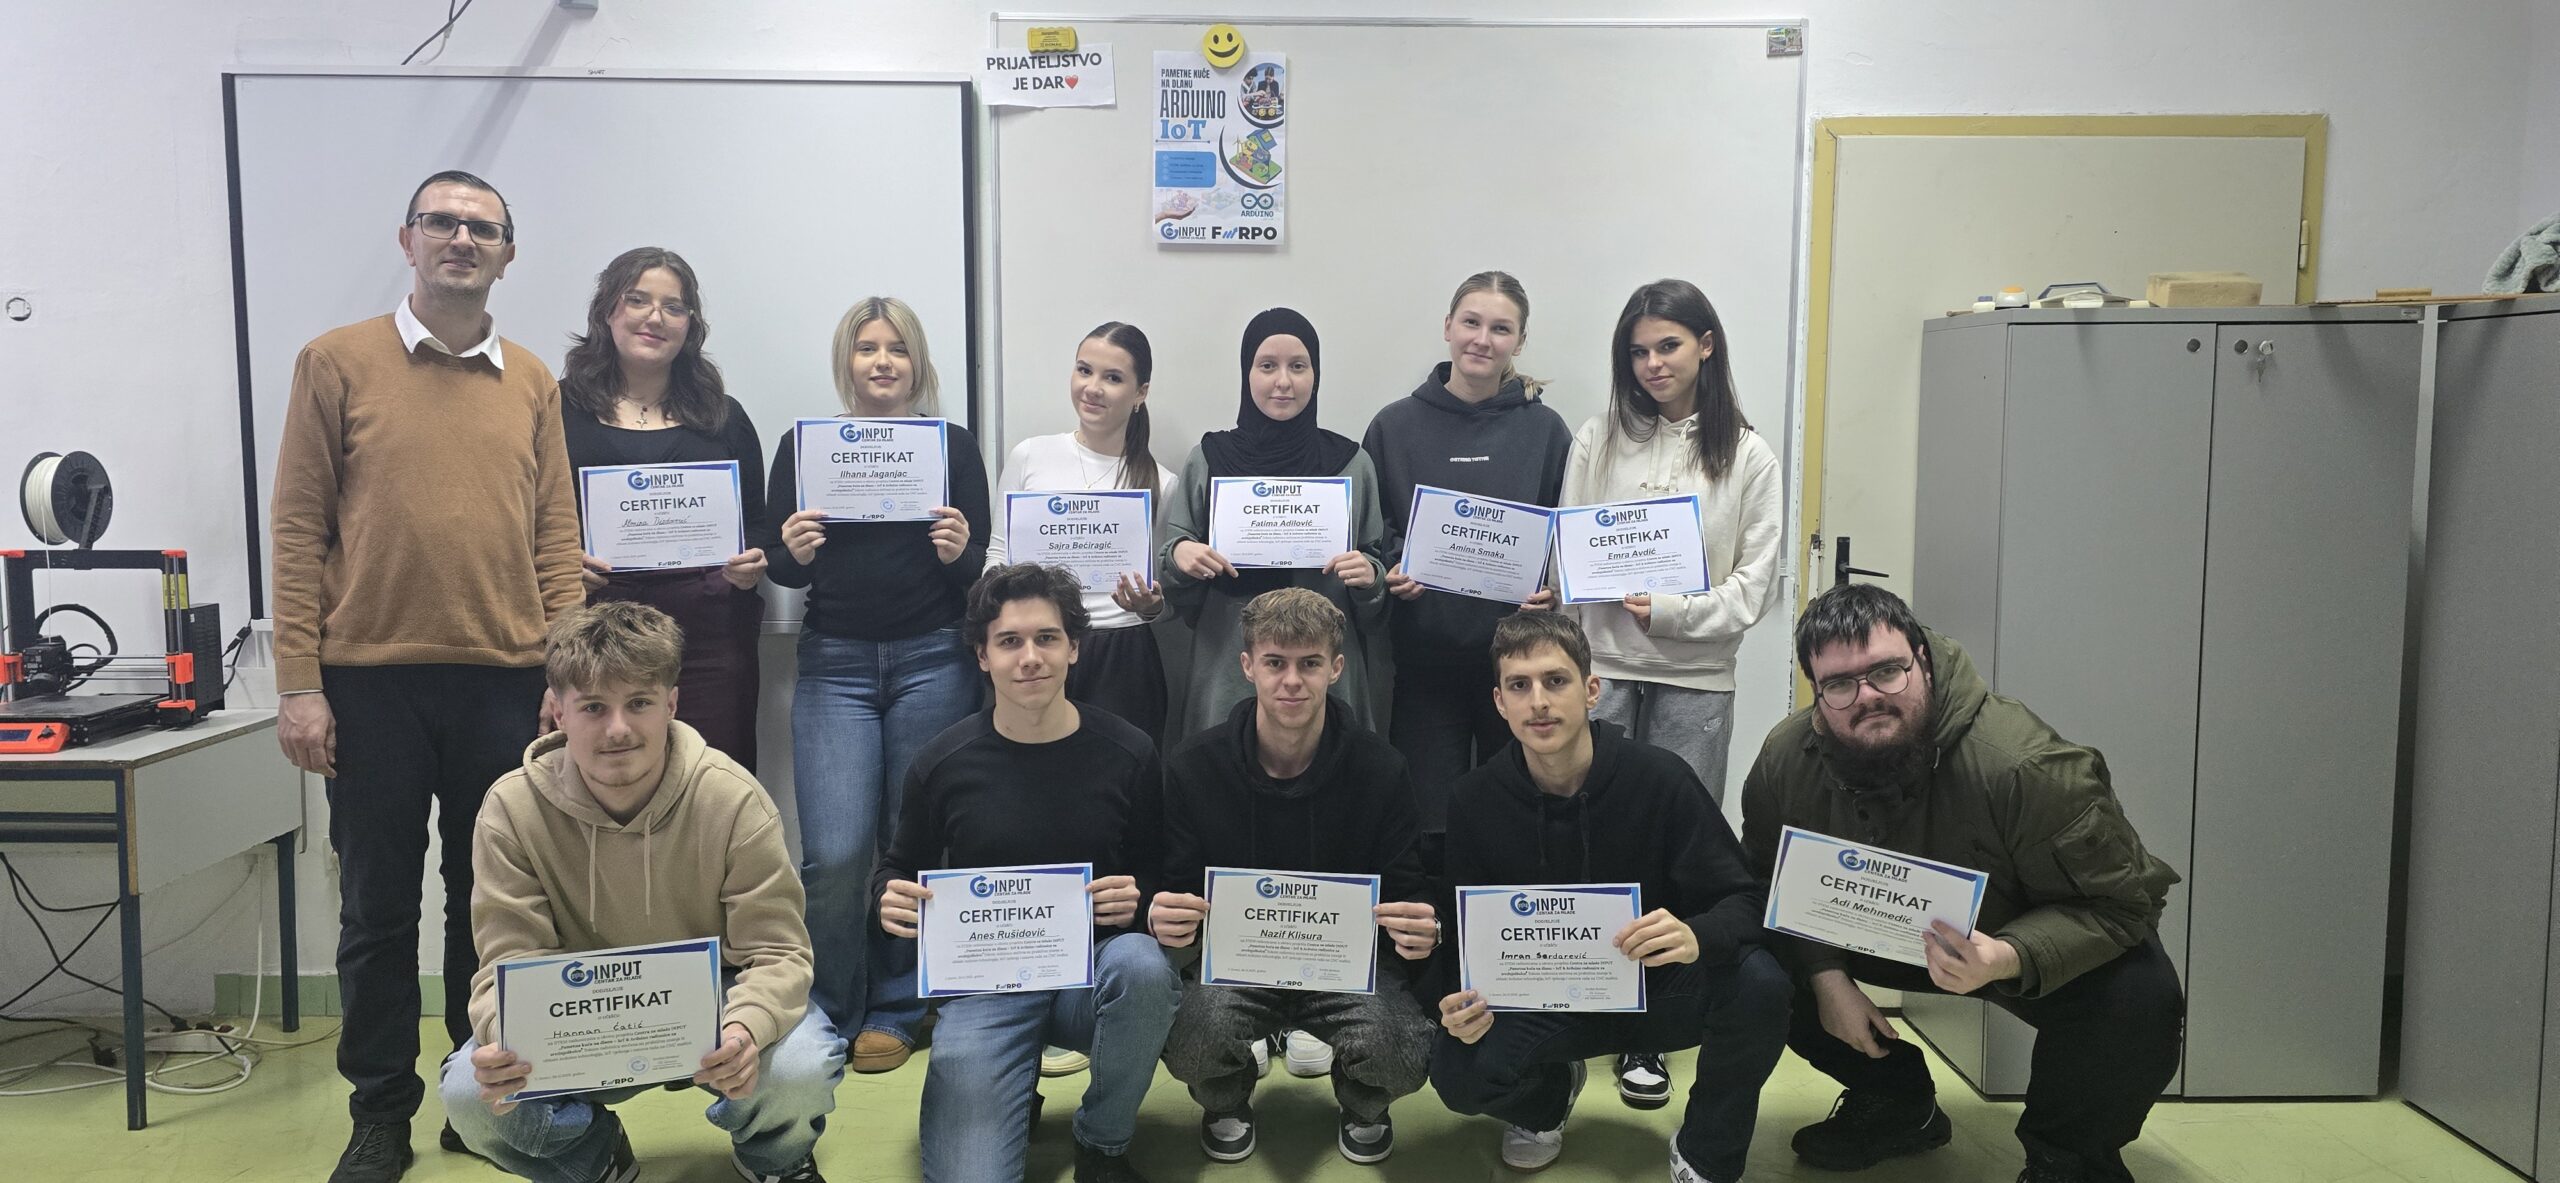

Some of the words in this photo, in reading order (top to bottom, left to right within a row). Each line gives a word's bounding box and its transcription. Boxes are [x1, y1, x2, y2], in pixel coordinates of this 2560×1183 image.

[986, 52, 1103, 71] PRIJATELJSTVO
[1160, 68, 1192, 79] PAMETNE
[1012, 77, 1028, 91] JE
[1032, 76, 1065, 90] DAR
[1160, 79, 1170, 89] NA
[1171, 79, 1193, 89] DLANU
[1159, 88, 1227, 119] ARDUINO
[1160, 119, 1207, 140] IoT
[1240, 210, 1275, 218] ARDUINO
[1178, 226, 1207, 238] INPUT
[861, 427, 894, 440] INPUT
[831, 451, 915, 464] CERTIFIKAT
[650, 473, 685, 485] INPUT
[868, 469, 908, 480] Jaganjac
[1271, 484, 1303, 495] INPUT
[619, 496, 707, 512] CERTIFIKAT
[1068, 499, 1100, 511] INPUT
[1243, 504, 1321, 515] CERTIFIKAT
[1473, 504, 1506, 522] INPUT
[1615, 508, 1648, 522] INPUT
[1039, 523, 1120, 536] CERTIFIKAT
[1250, 520, 1278, 528] Fatima
[1279, 519, 1313, 527] Adilović
[1441, 523, 1520, 547] CERTIFIKAT
[1589, 528, 1670, 548] CERTIFIKAT
[1048, 541, 1070, 551] Sajra
[1072, 540, 1113, 551] Bećiragić
[1449, 542, 1476, 555] Amina
[1477, 547, 1505, 559] Smaka
[1607, 551, 1630, 561] Emra
[1631, 547, 1657, 558] Avdić
[1866, 858, 1912, 880] INPUT
[994, 878, 1032, 893] INPUT
[1280, 882, 1319, 897] INPUT
[1820, 874, 1933, 912] CERTIFIKAT
[1536, 897, 1576, 912] INPUT
[1830, 896, 1851, 909] Adi
[1852, 900, 1913, 926] Mehmedić
[959, 905, 1055, 924] CERTIFIKAT
[1244, 907, 1340, 925] CERTIFIKAT
[969, 930, 995, 941] Anes
[997, 928, 1046, 940] Rušidović
[1260, 928, 1286, 939] Nazif
[1287, 930, 1323, 941] Klisura
[1500, 927, 1602, 941] CERTIFIKAT
[1500, 951, 1531, 960] Imran
[593, 960, 643, 980] INPUT
[549, 989, 673, 1018] CERTIFIKAT
[553, 1028, 601, 1039] Hannan
